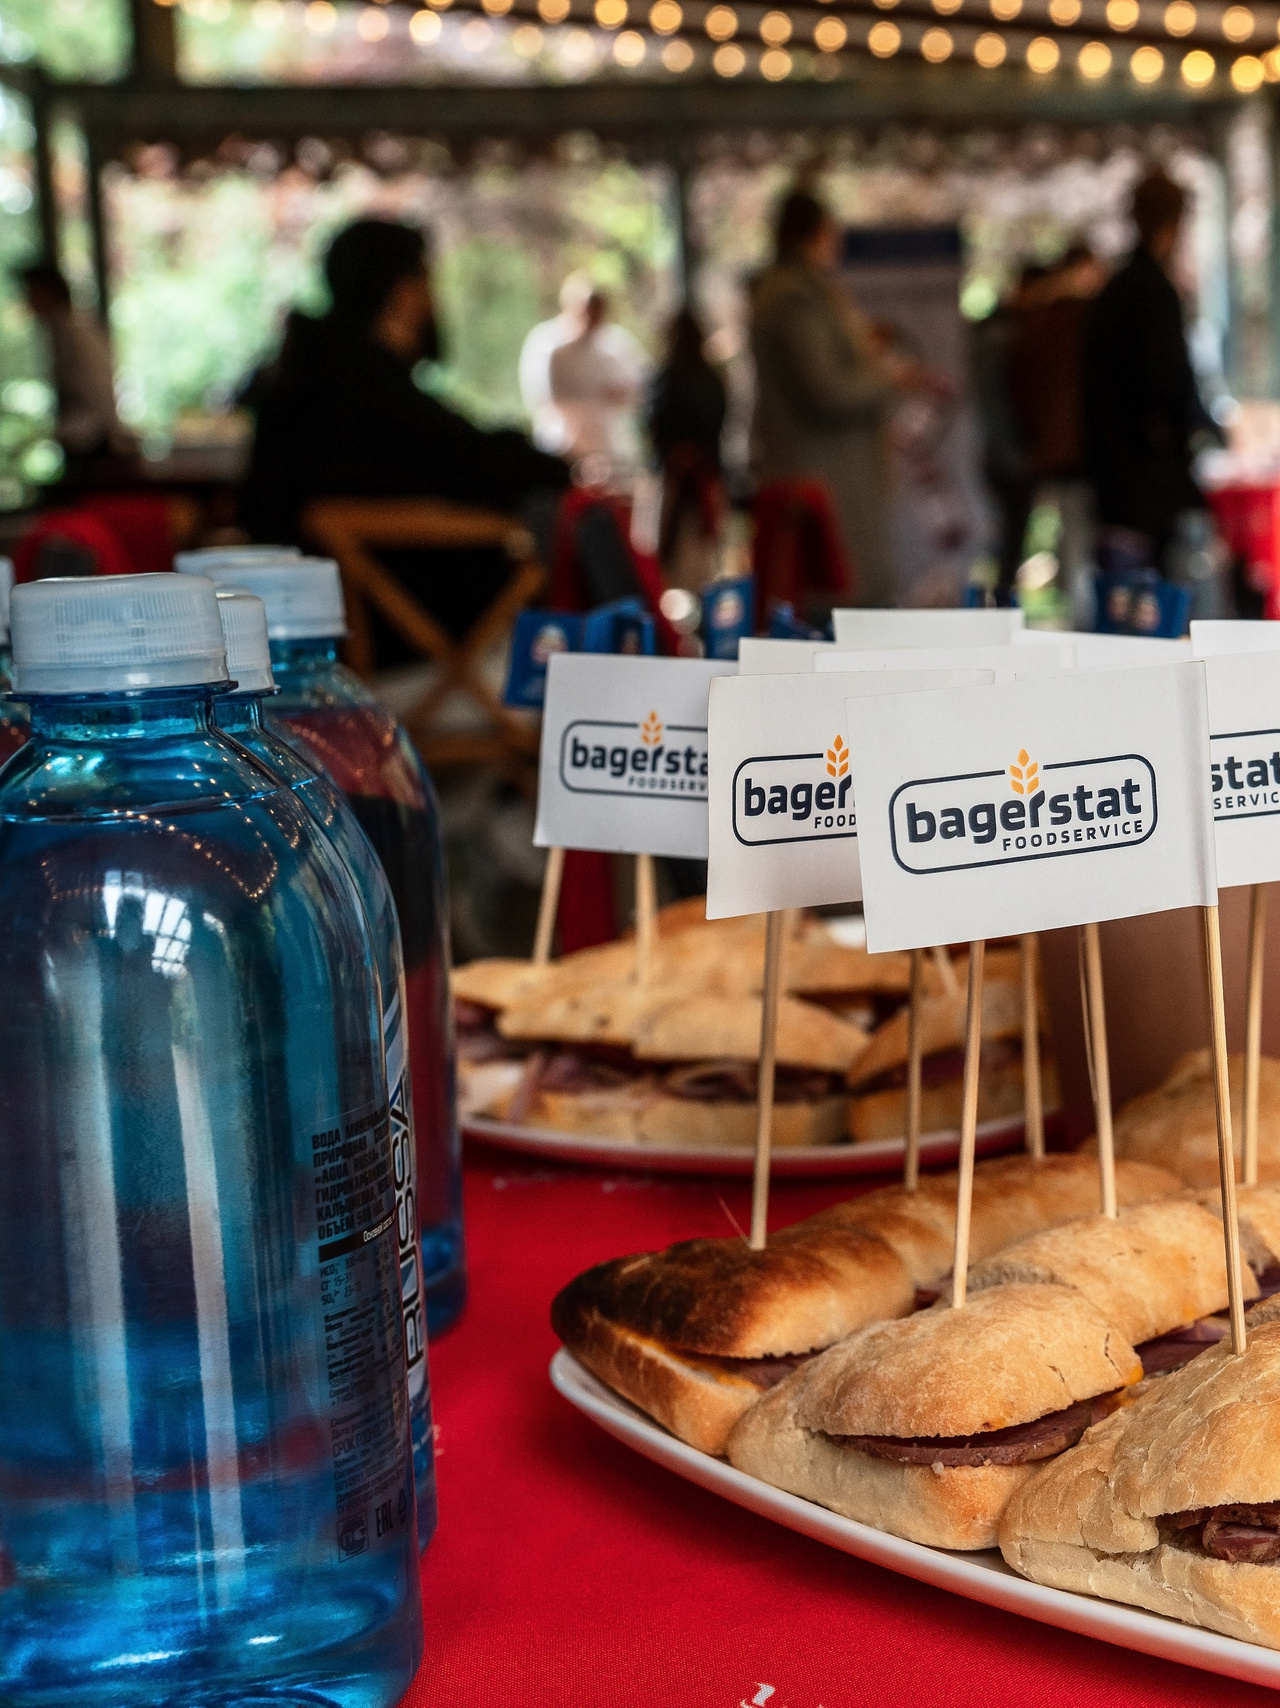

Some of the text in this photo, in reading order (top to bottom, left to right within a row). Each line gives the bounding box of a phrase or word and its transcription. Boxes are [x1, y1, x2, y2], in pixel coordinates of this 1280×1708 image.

[744, 774, 855, 821] bager
[905, 778, 1142, 844] bagerstat
[814, 813, 857, 829] FOOD
[1002, 819, 1143, 851] FOODSERVICE
[312, 1128, 341, 1150] ВОДА
